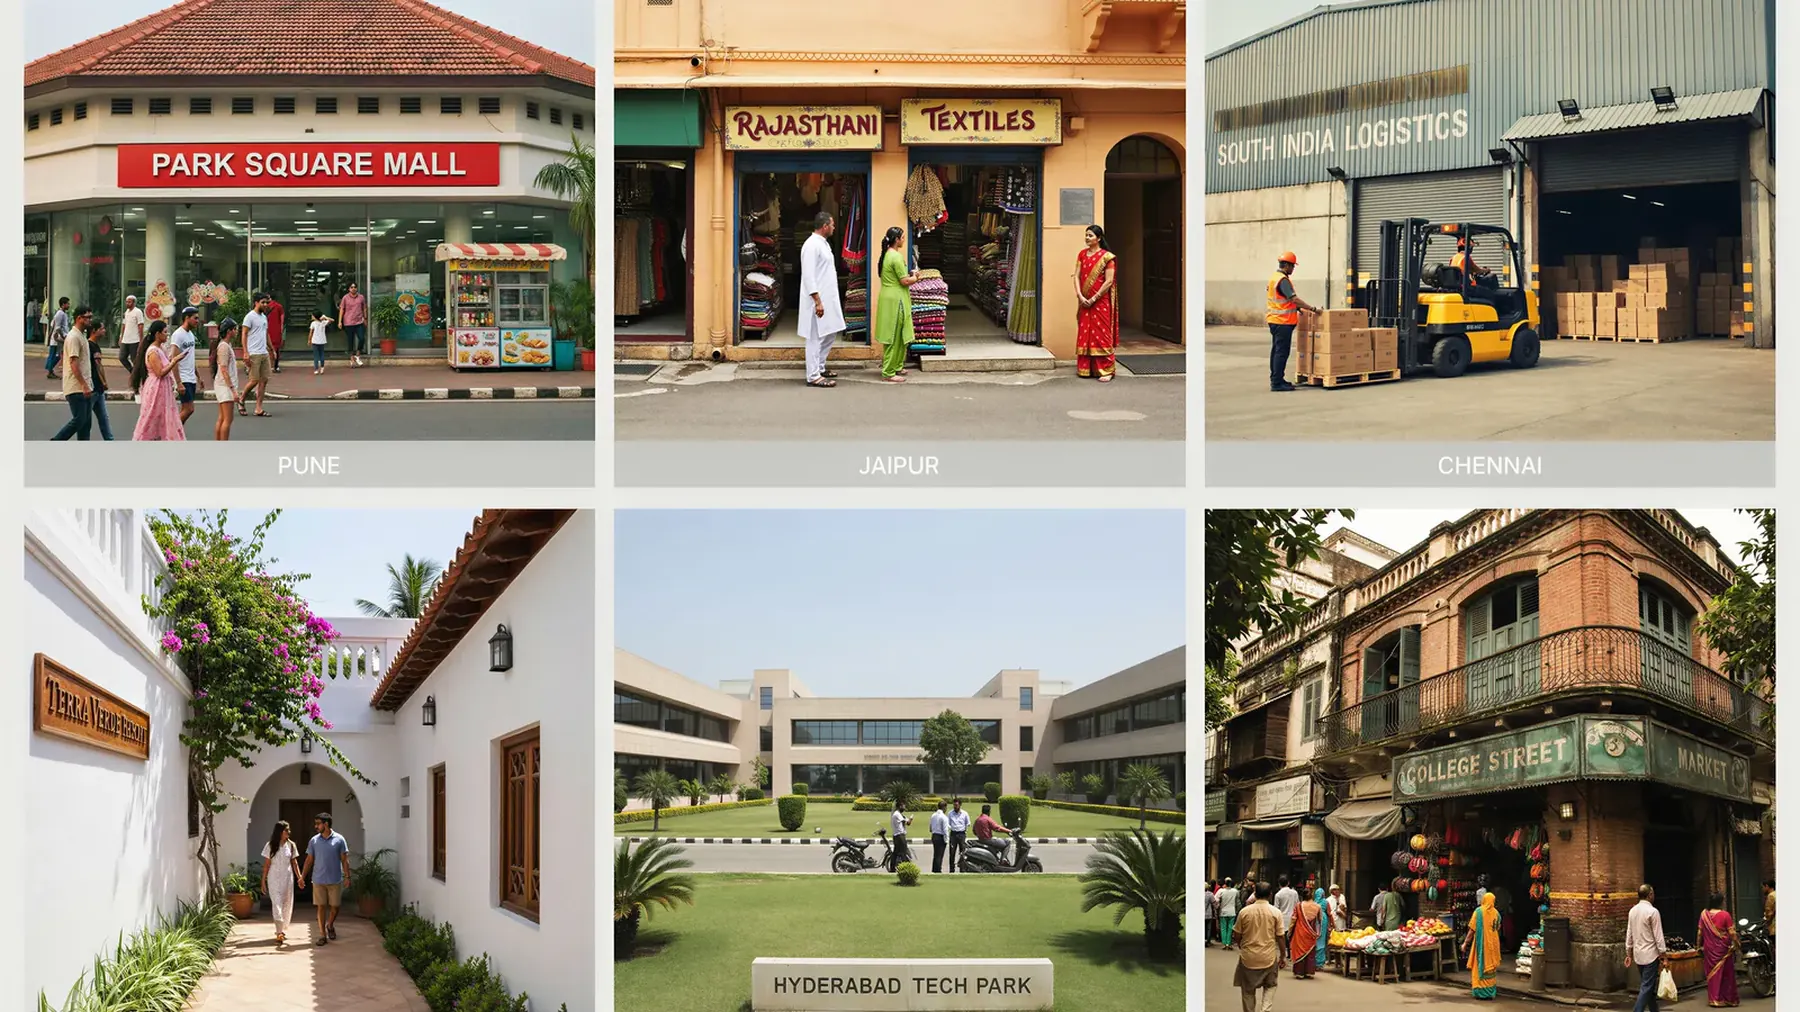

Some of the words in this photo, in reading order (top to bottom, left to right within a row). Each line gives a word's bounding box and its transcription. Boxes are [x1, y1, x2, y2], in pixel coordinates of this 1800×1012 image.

[733, 111, 877, 141] RAJASTHANI
[920, 103, 1036, 131] TEXTILES
[1217, 136, 1275, 166] SOUTH
[1283, 128, 1334, 159] INDIA
[1345, 108, 1468, 151] LOGISTICS
[152, 152, 236, 176] PARK
[245, 152, 373, 179] SQUARE
[384, 152, 467, 176] MALL
[46, 675, 89, 724] TERRA
[90, 695, 120, 734] VERDE
[1407, 754, 1481, 785] COLLEGE
[1489, 737, 1567, 772] STREET
[1677, 747, 1727, 781] MARKET
[774, 976, 902, 994] HYDERABAD
[912, 976, 968, 994] TECH
[976, 976, 1032, 994] PARK
